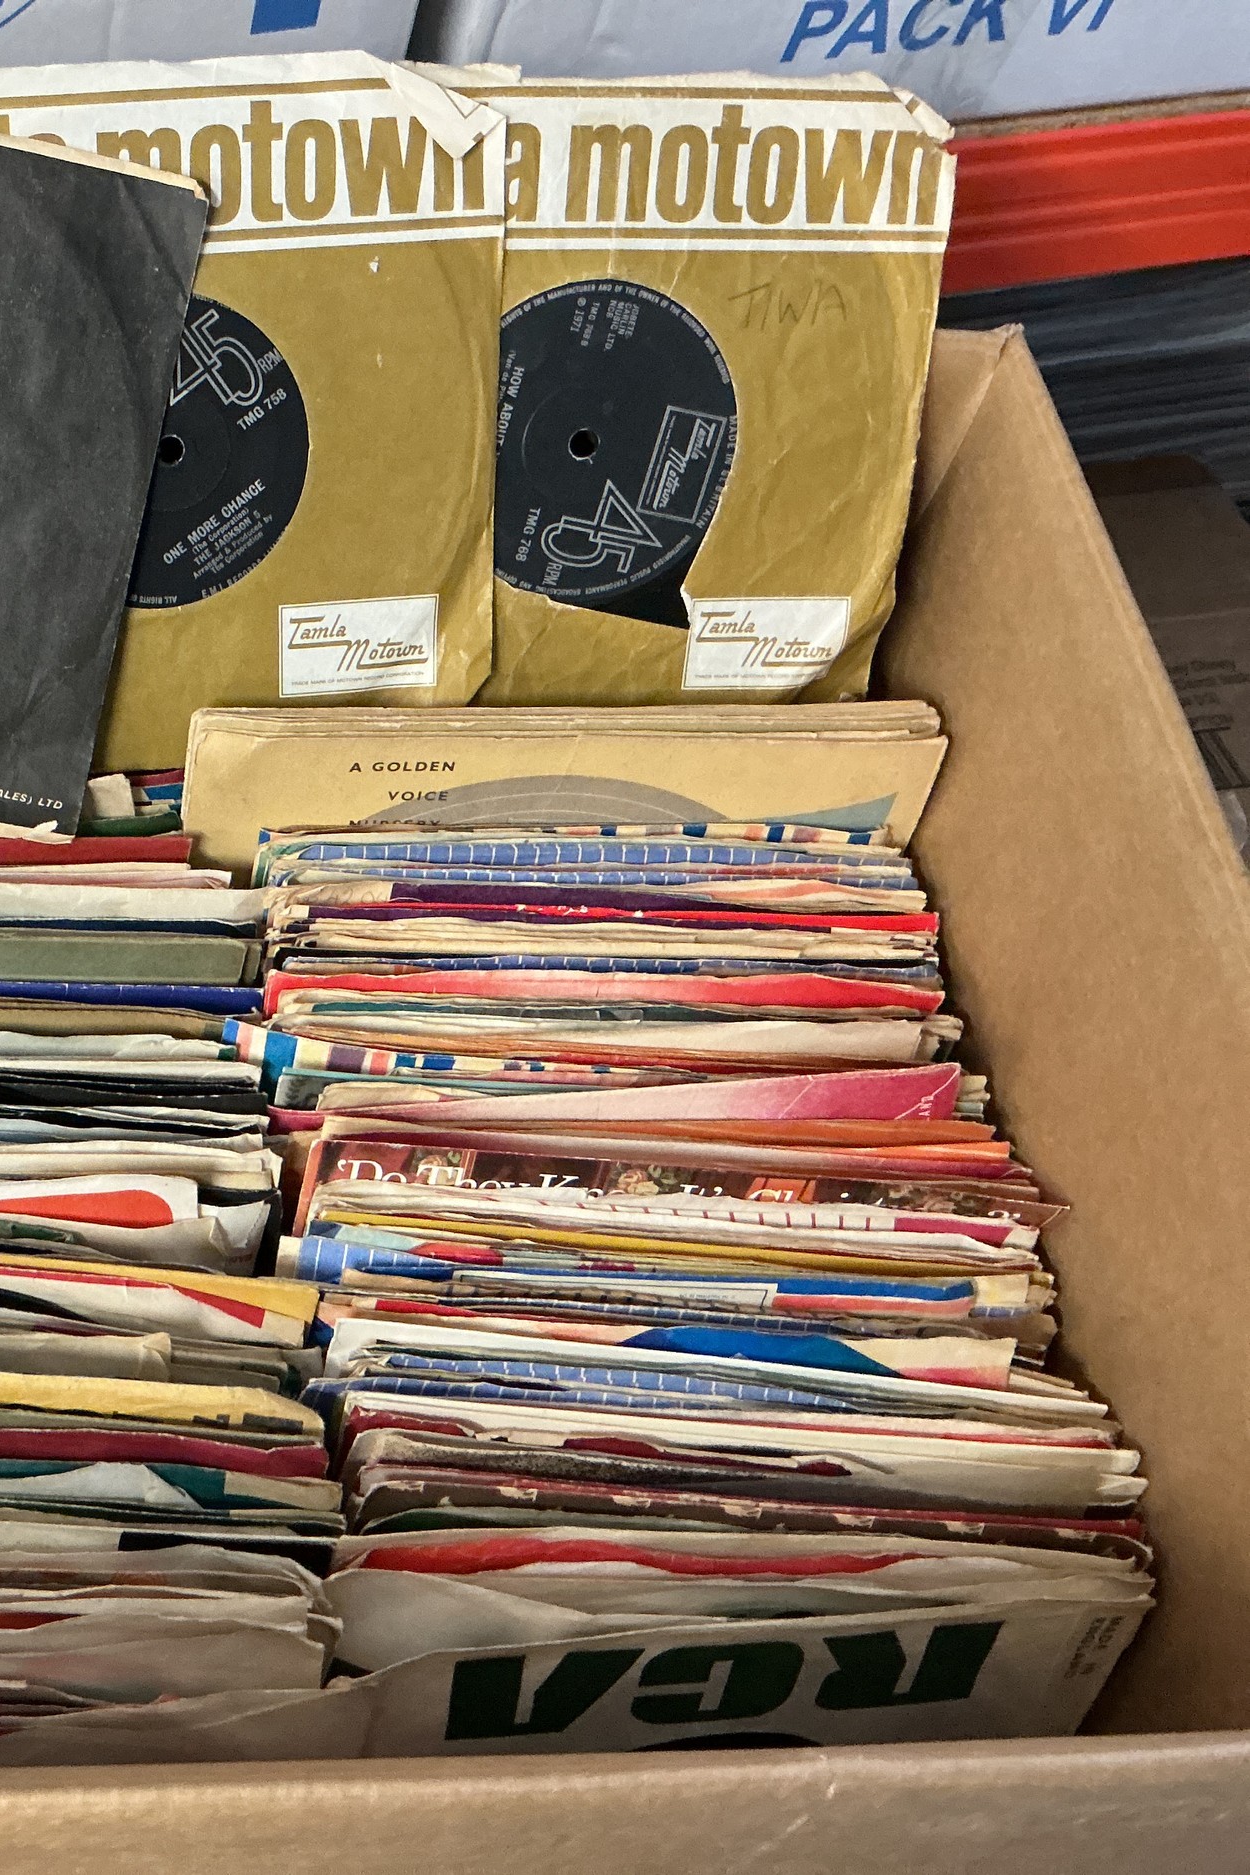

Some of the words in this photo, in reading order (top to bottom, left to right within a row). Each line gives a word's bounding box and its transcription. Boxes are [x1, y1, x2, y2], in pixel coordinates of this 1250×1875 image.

[780, 0, 1005, 63] PACK
[565, 104, 943, 226] motown
[570, 309, 585, 332] 1971
[610, 302, 625, 330] MUSIC
[507, 366, 525, 398] HOW
[237, 406, 265, 430] TMG
[263, 388, 287, 409] 758
[497, 402, 514, 446] ABOUT
[163, 541, 188, 565] ONE
[187, 514, 221, 546] MORE
[221, 479, 266, 518] CHANCE
[208, 507, 249, 542] Corporation)
[523, 507, 541, 535] TMG
[541, 478, 663, 573] 45
[194, 549, 212, 565] THE
[214, 517, 252, 551] JACKSON
[515, 539, 532, 562] 768
[288, 614, 347, 649] Tamla
[696, 610, 756, 642] Tamla
[337, 637, 428, 672] Motown
[741, 637, 833, 667] Motown
[349, 762, 362, 773] A
[372, 761, 456, 772] GOLDEN
[38, 798, 63, 810] LTD
[388, 791, 449, 801] VOICE
[417, 1164, 530, 1189] Th
[445, 1620, 1006, 1741] RCA
